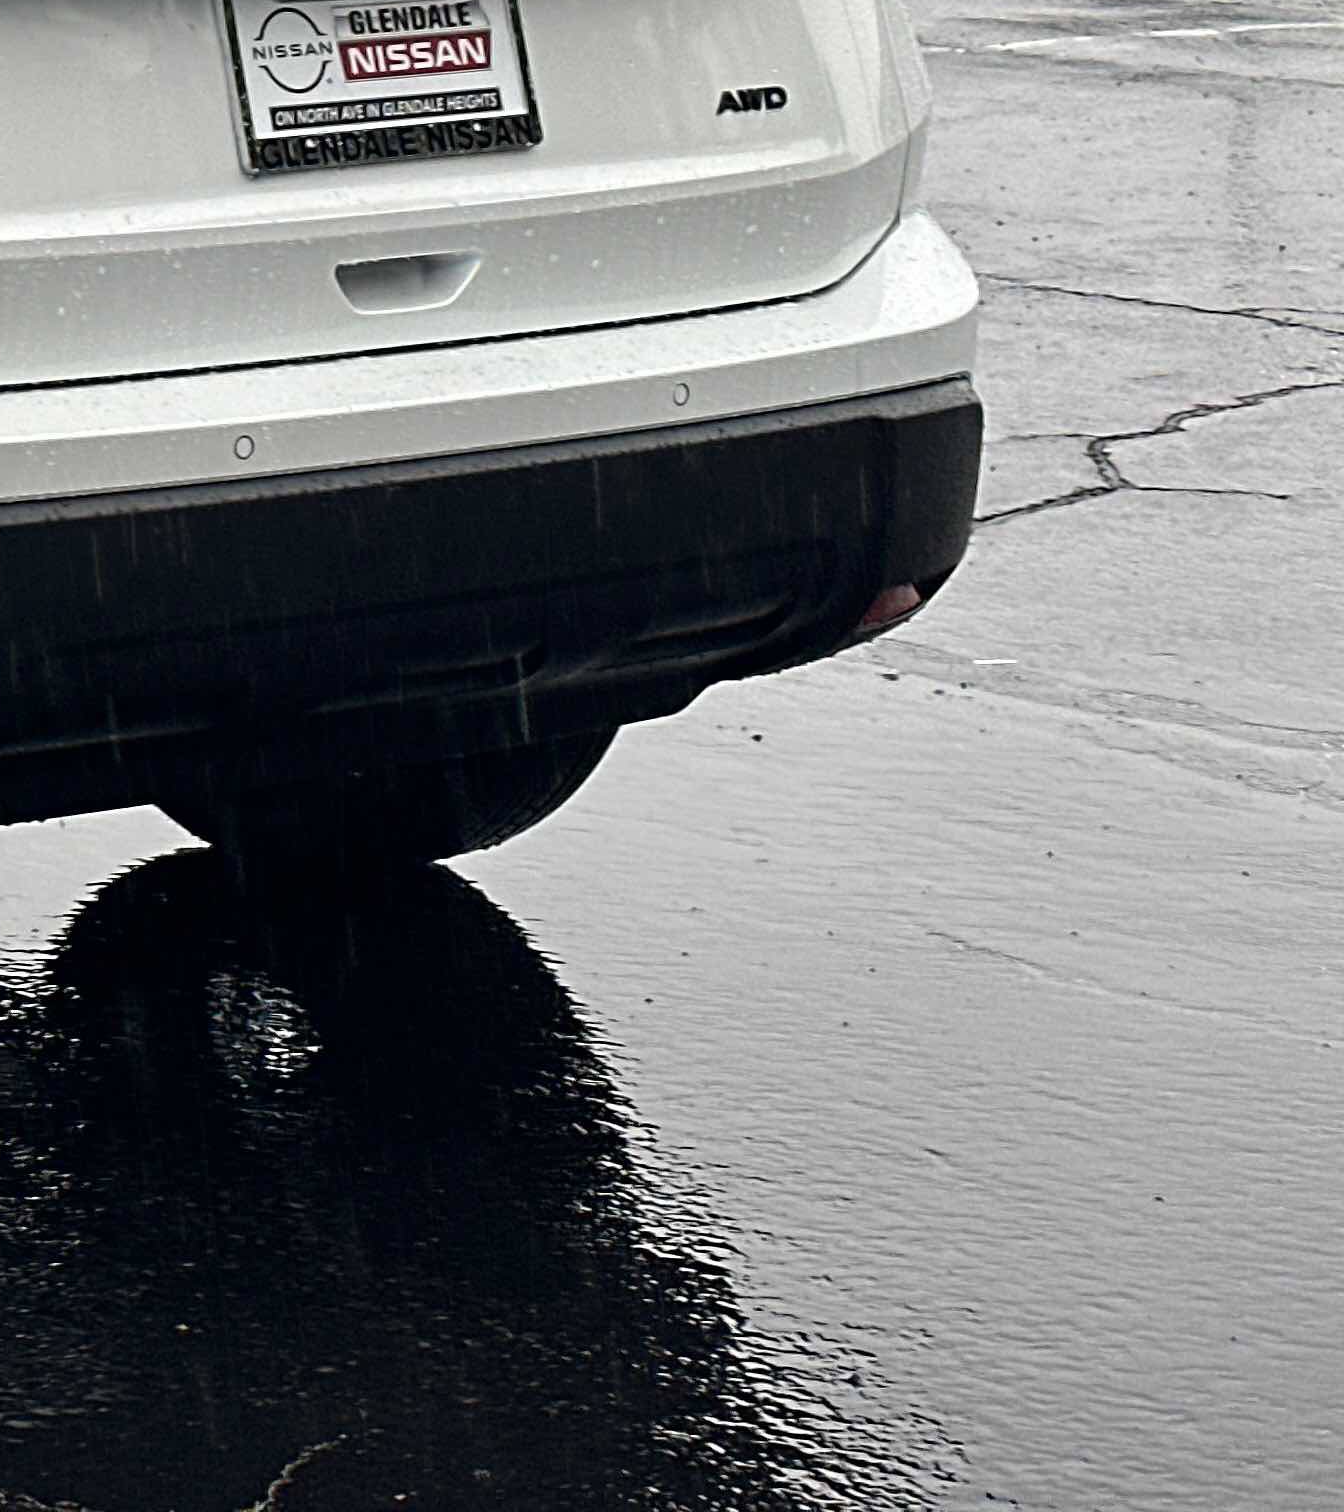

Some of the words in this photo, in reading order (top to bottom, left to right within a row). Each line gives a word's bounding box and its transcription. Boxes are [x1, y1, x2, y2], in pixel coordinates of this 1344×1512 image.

[349, 2, 473, 35] GLENDALE
[253, 41, 334, 61] NISSAN
[347, 38, 486, 76] NISSAN
[275, 110, 295, 126] ON
[297, 106, 339, 124] NORTH
[341, 104, 365, 120] AVE
[366, 102, 380, 118] IN
[382, 96, 445, 116] GLENDALE
[447, 92, 497, 111] HEIGHTS
[716, 87, 788, 115] AWD
[261, 126, 417, 169] GLENDALE
[428, 116, 534, 153] NISSAN
